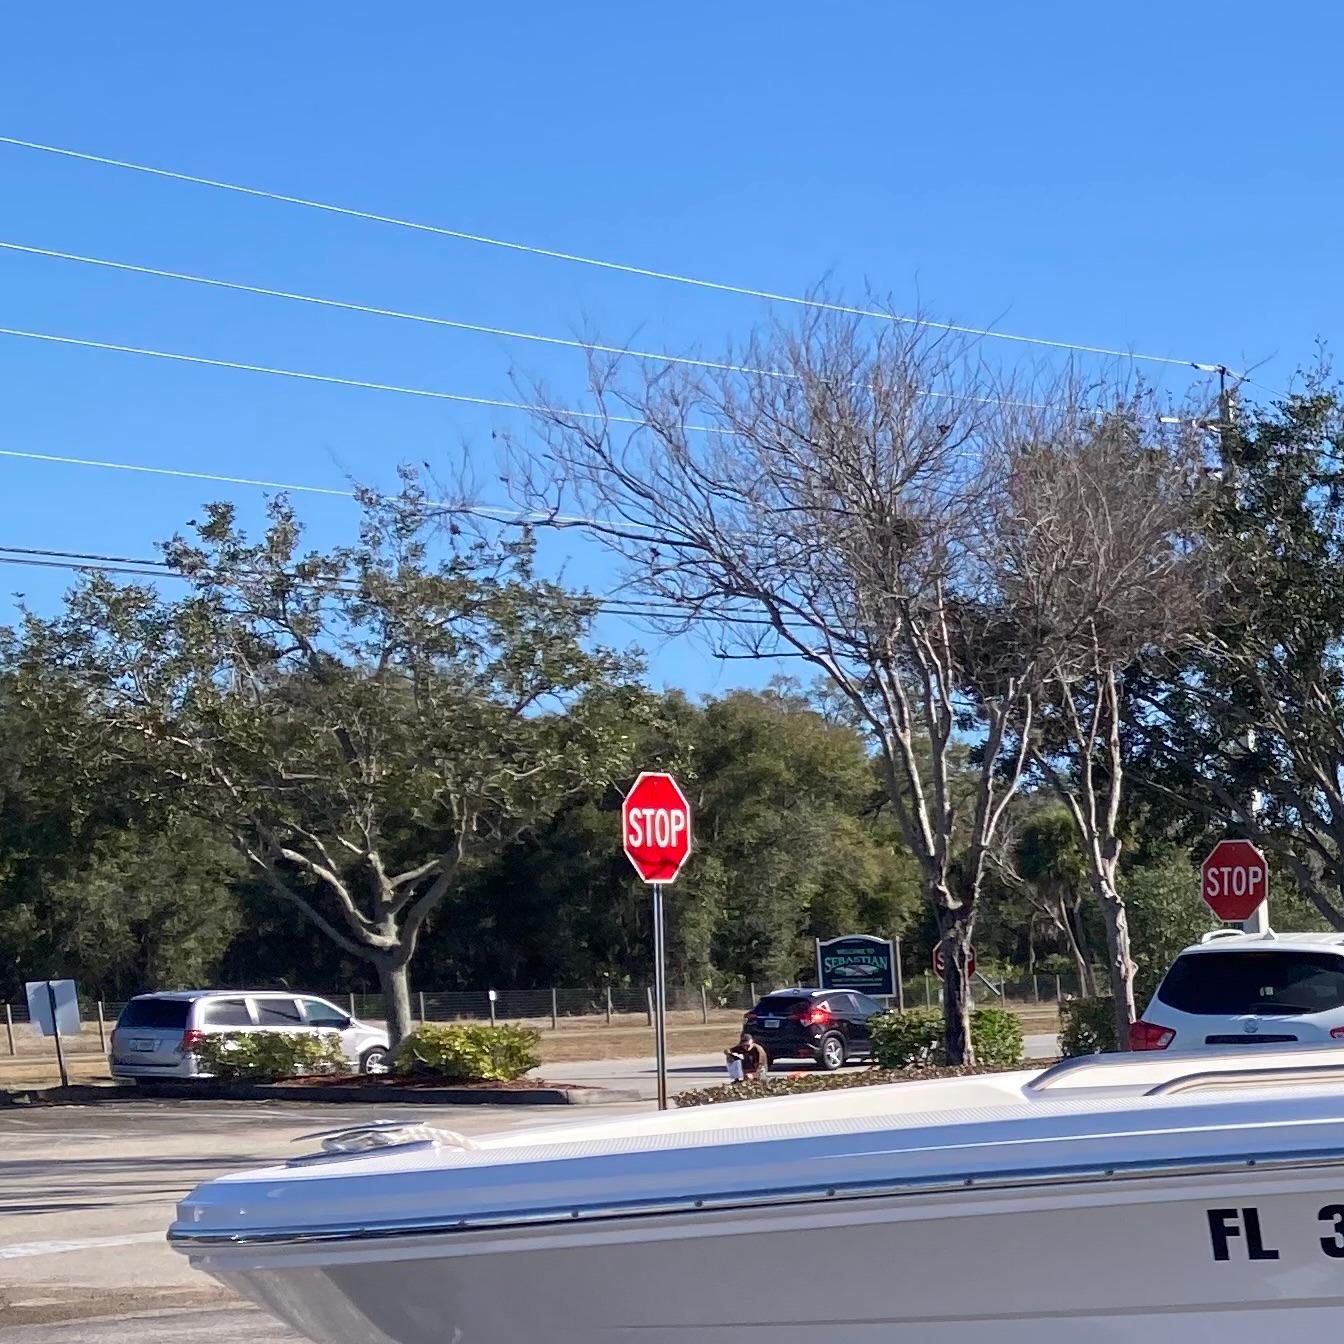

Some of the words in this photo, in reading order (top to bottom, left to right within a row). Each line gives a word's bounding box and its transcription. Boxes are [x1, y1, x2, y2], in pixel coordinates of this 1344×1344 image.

[628, 807, 685, 848] STOP
[1206, 865, 1262, 897] STOP
[824, 956, 888, 973] SEBASTIAN
[1207, 1207, 1280, 1261] FL
